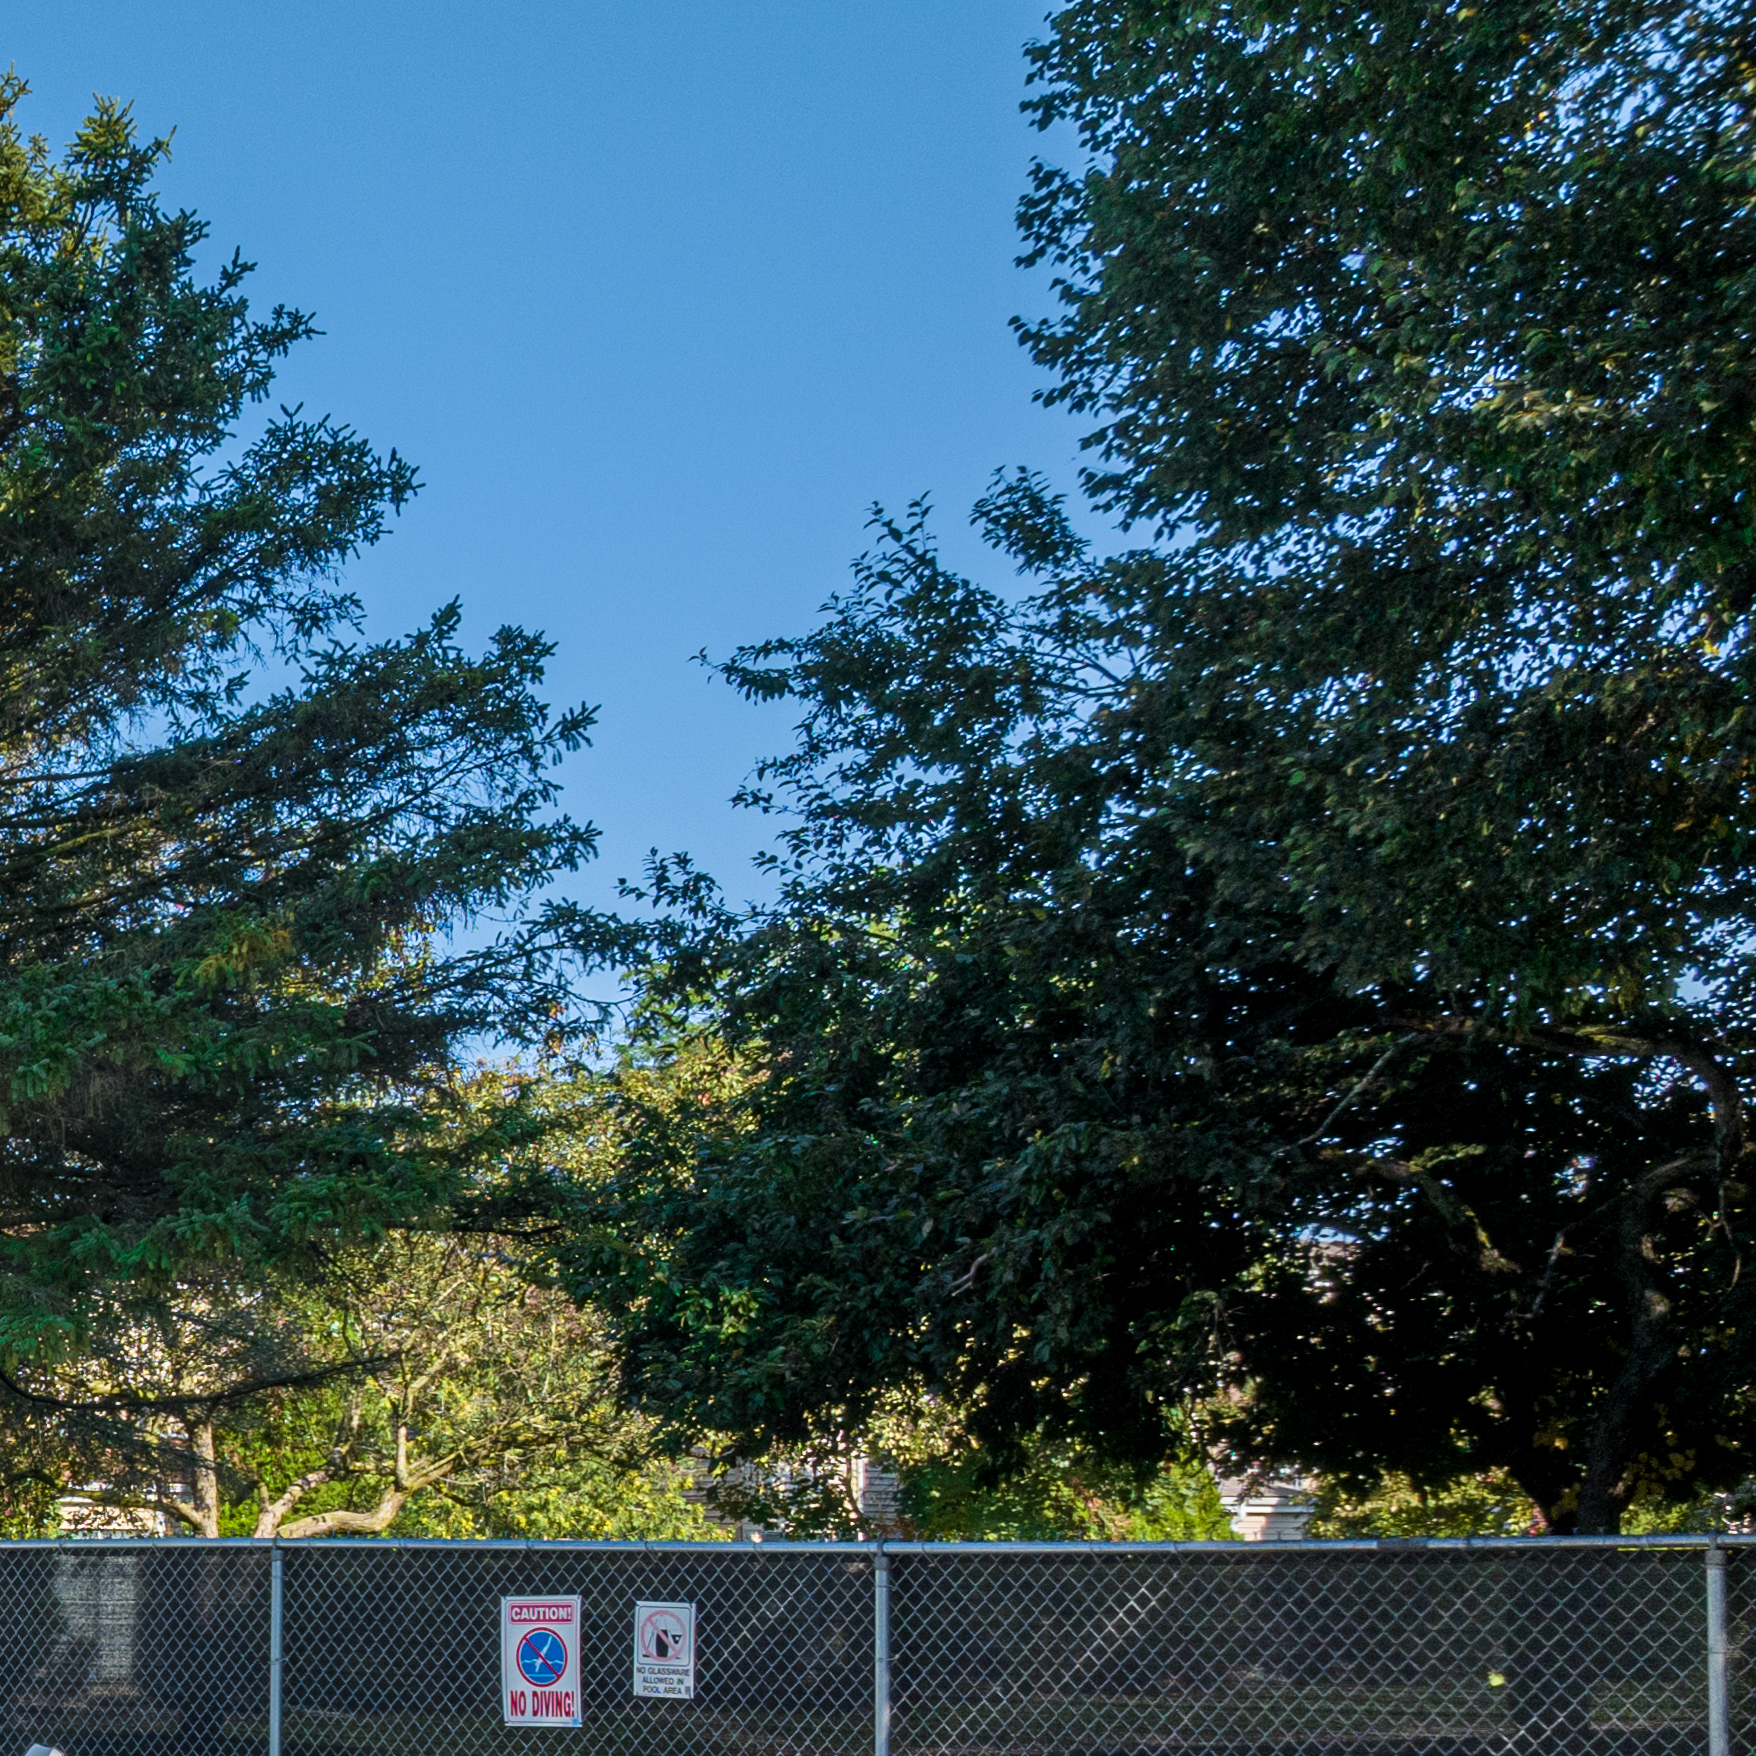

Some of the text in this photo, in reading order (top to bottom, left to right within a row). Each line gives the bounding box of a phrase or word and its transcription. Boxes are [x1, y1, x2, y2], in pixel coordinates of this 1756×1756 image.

[511, 1607, 572, 1620] CAUTION!
[637, 1666, 646, 1674] NO
[642, 1676, 684, 1685] ALLOWED IN
[643, 1685, 683, 1694] POOL AREA
[510, 1690, 574, 1717] NO DIVING!
